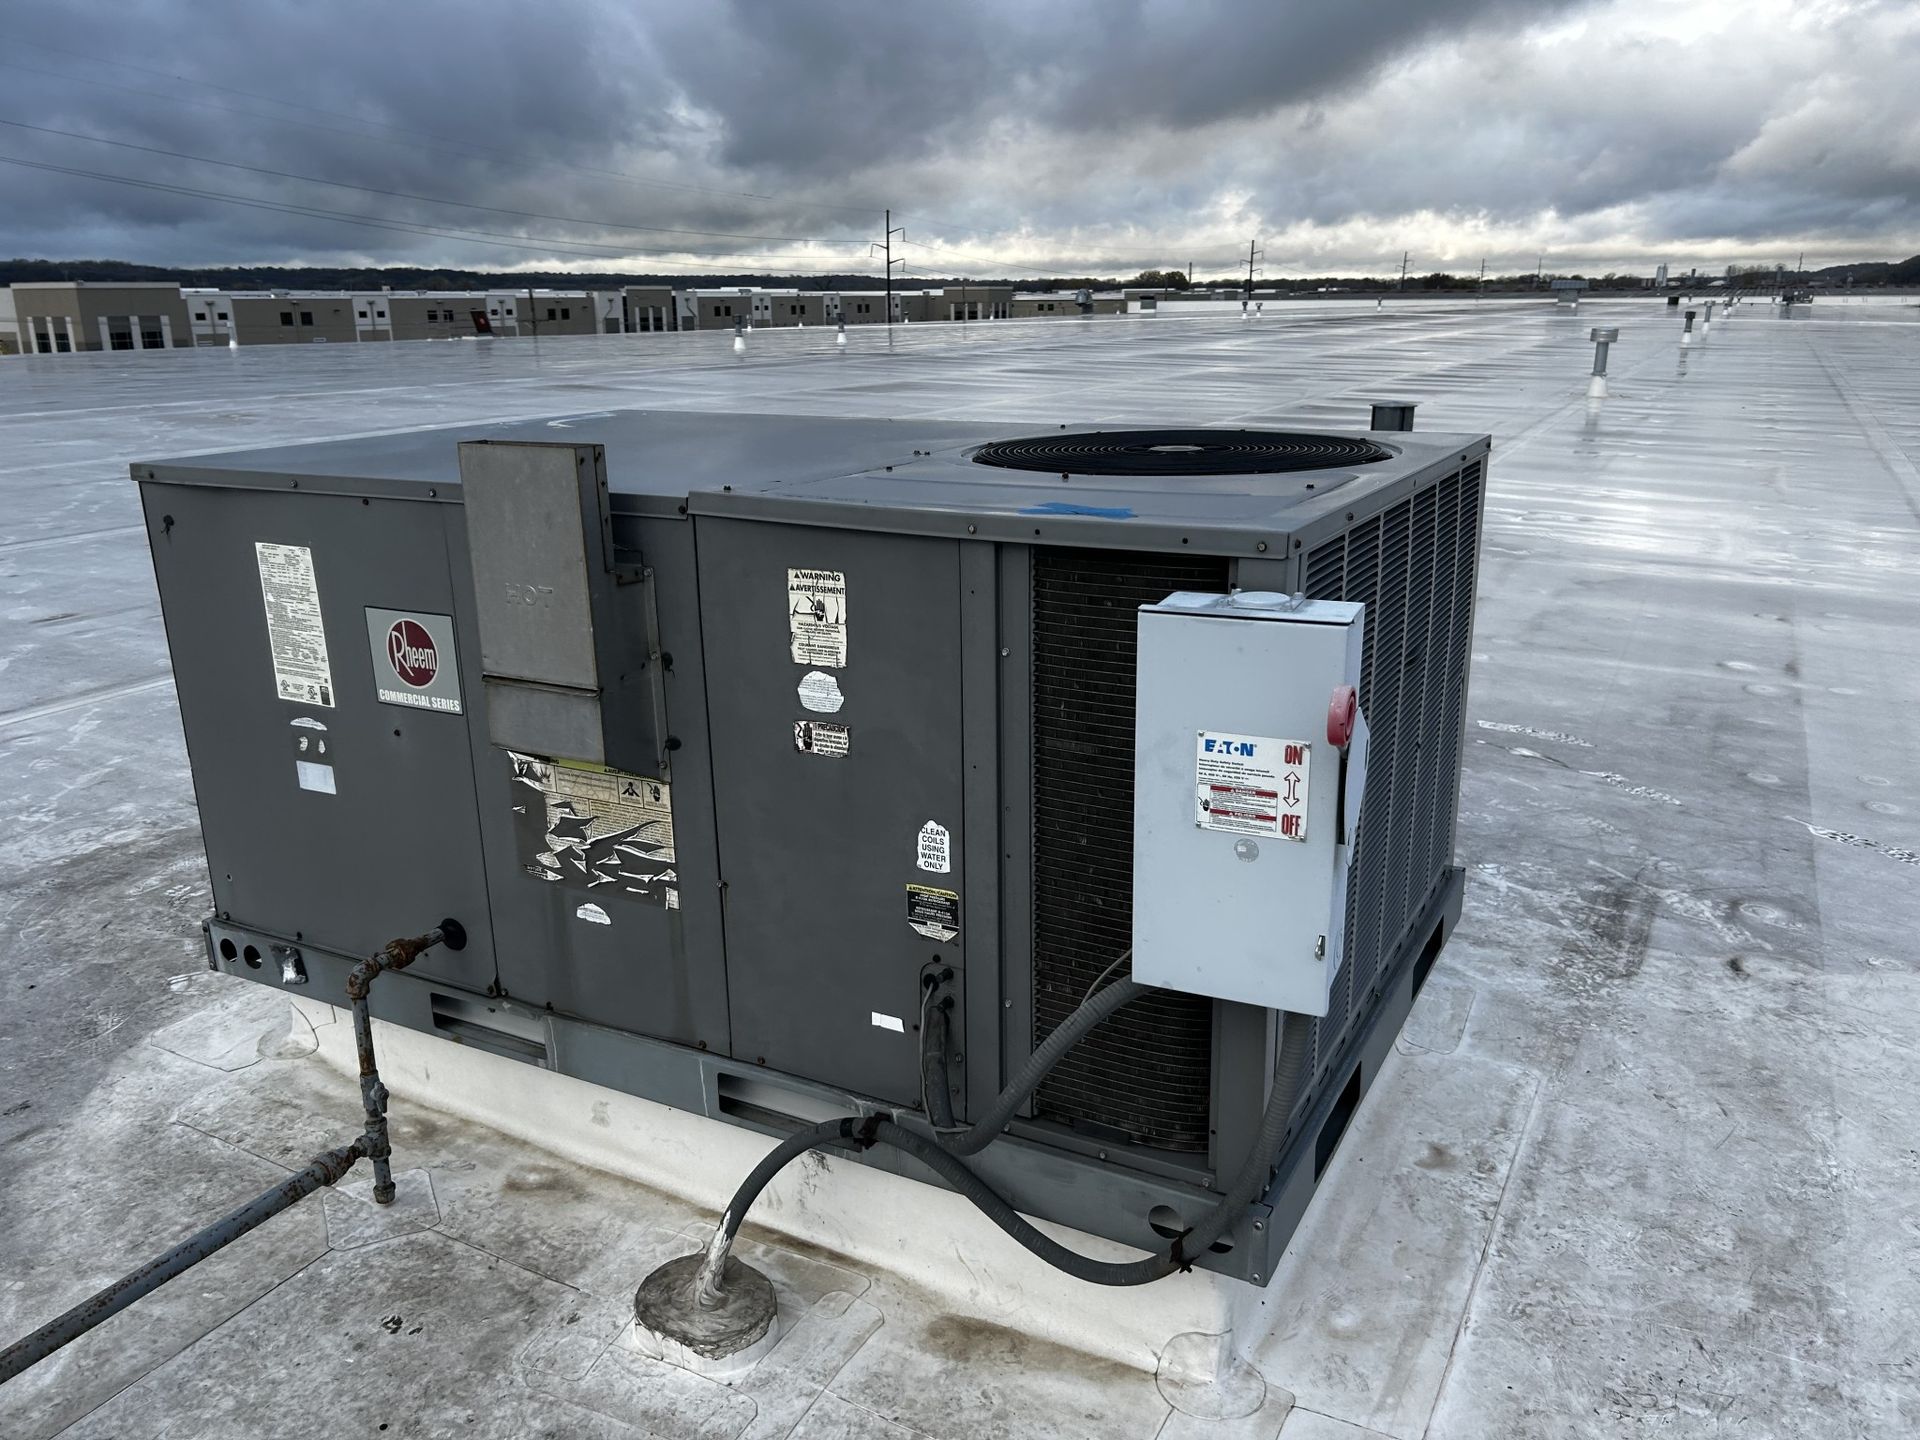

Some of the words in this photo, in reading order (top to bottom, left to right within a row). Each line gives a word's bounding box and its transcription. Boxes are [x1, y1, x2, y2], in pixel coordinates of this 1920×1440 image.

[800, 571, 841, 582] WARNING
[504, 582, 554, 608] HOT
[796, 584, 845, 595] AVERTISSEMENT
[391, 621, 436, 676] Rheem
[379, 688, 430, 707] COMMERCIAL
[431, 697, 460, 711] SERIES
[1205, 739, 1254, 757] EATON
[1284, 745, 1303, 765] ON
[1281, 814, 1301, 836] OFF
[921, 827, 946, 837] CLEAN
[922, 835, 945, 845] COILS
[922, 844, 945, 854] USING
[921, 852, 946, 863] WATER
[923, 861, 943, 870] ONLY
